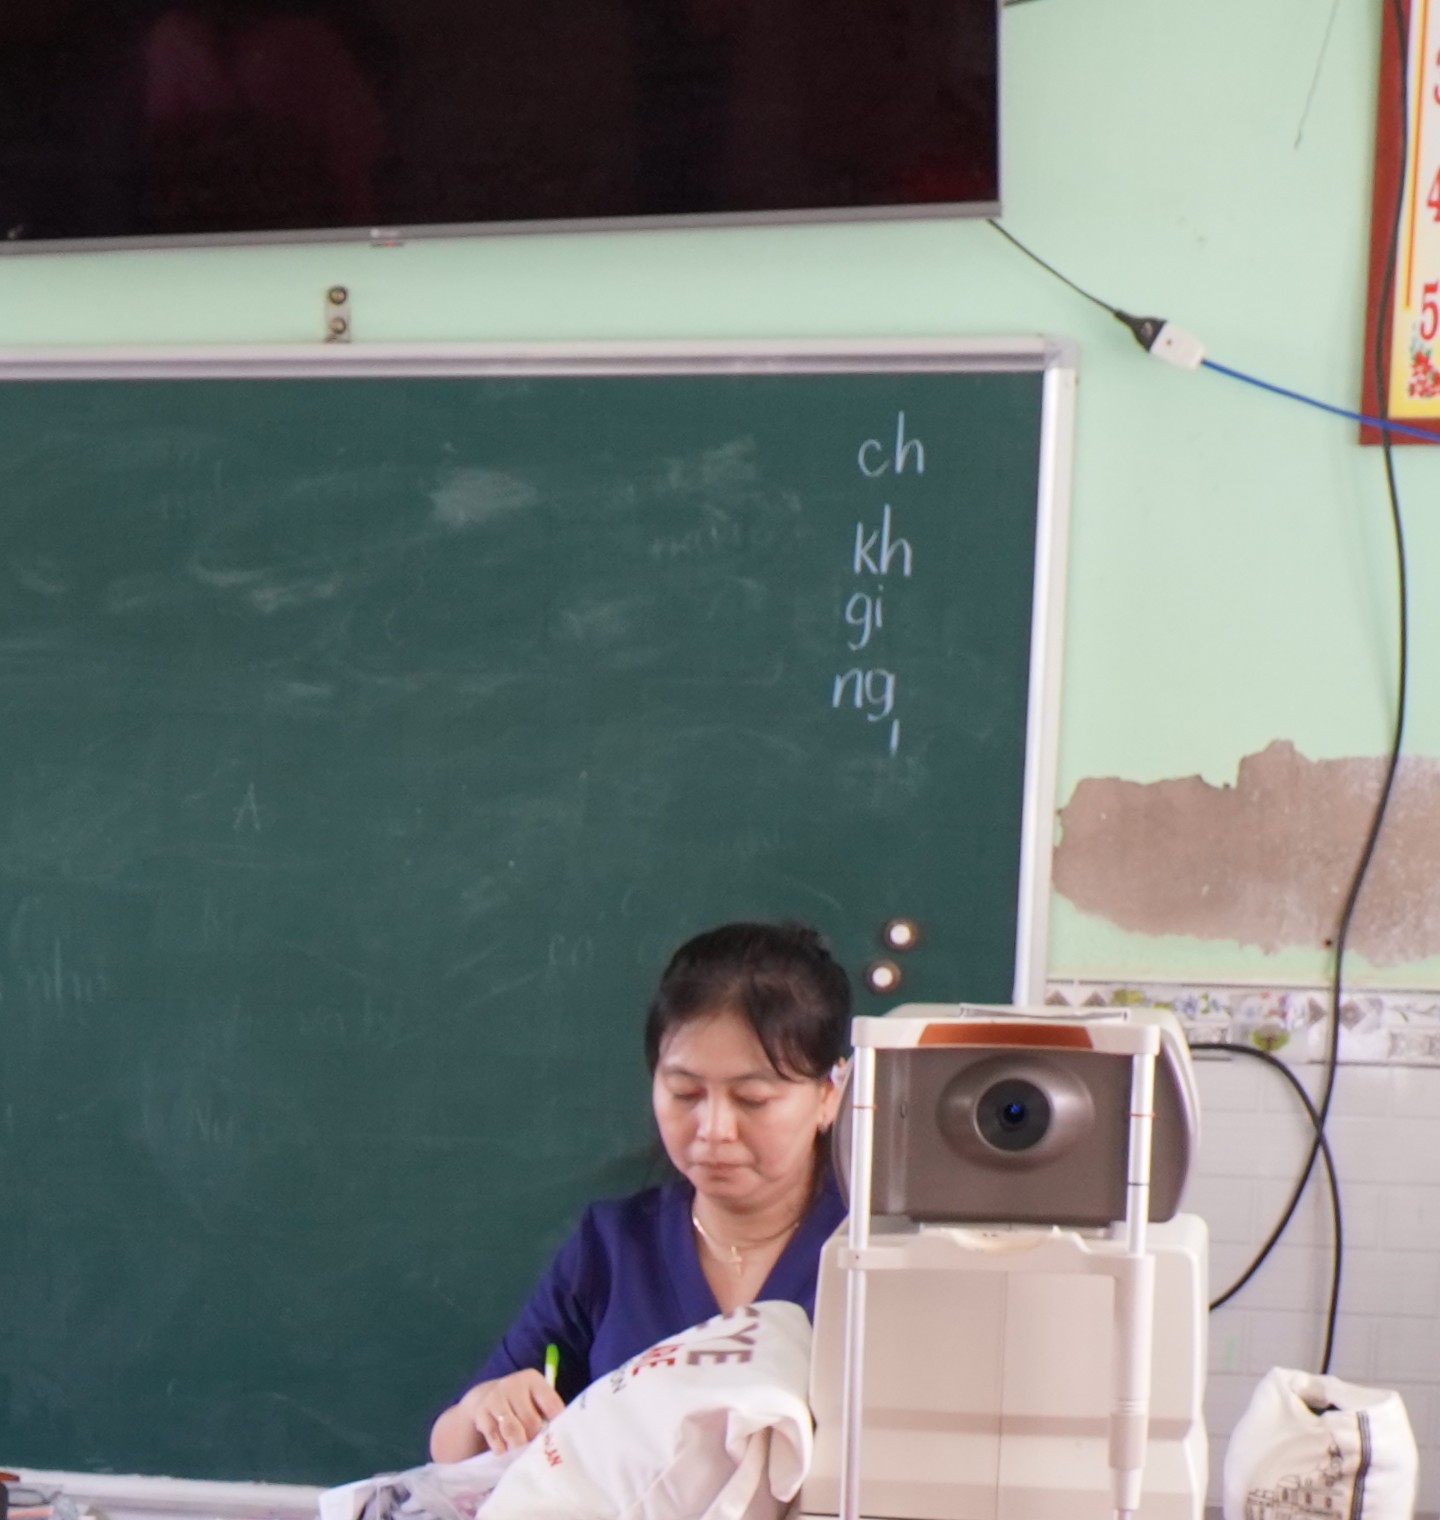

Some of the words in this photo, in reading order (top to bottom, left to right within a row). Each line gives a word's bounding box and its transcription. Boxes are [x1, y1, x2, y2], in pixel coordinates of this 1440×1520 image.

[1420, 280, 1440, 342] 5
[857, 410, 925, 478] ch
[852, 503, 913, 577] kh
[844, 584, 884, 652] gi
[832, 666, 896, 722] ng
